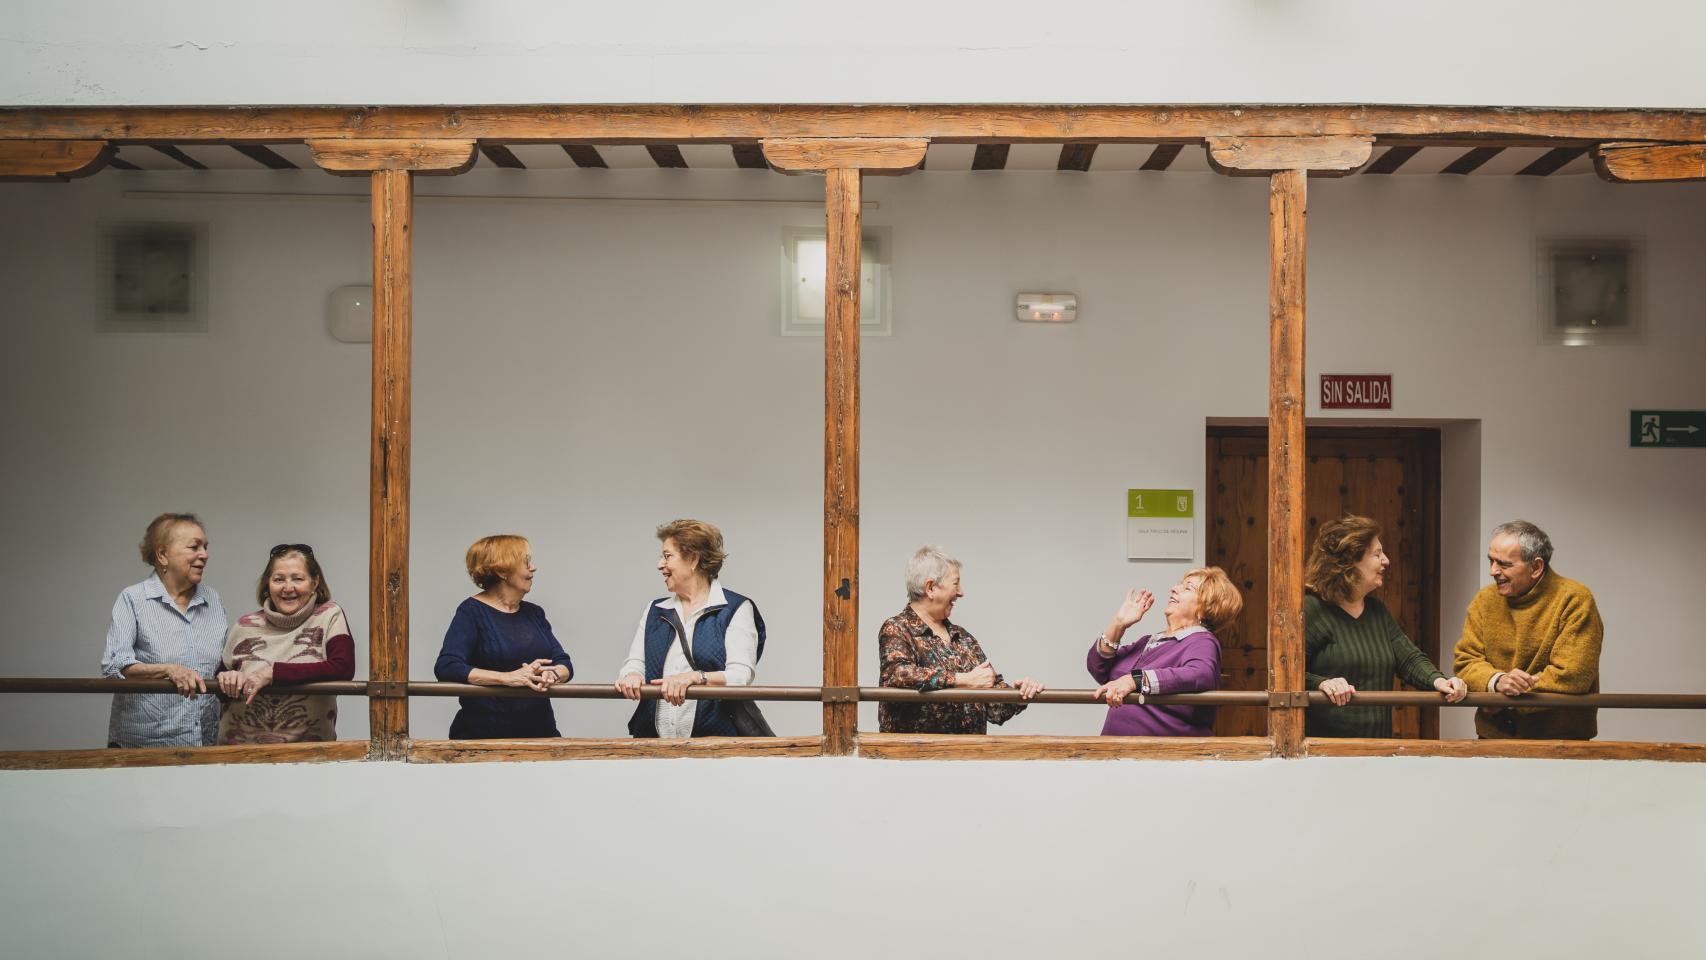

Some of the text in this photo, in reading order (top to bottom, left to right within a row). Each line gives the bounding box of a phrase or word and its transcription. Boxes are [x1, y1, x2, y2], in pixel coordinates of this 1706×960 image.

[1323, 380, 1390, 403] SIN SALIDA
[1135, 494, 1145, 510] 1
